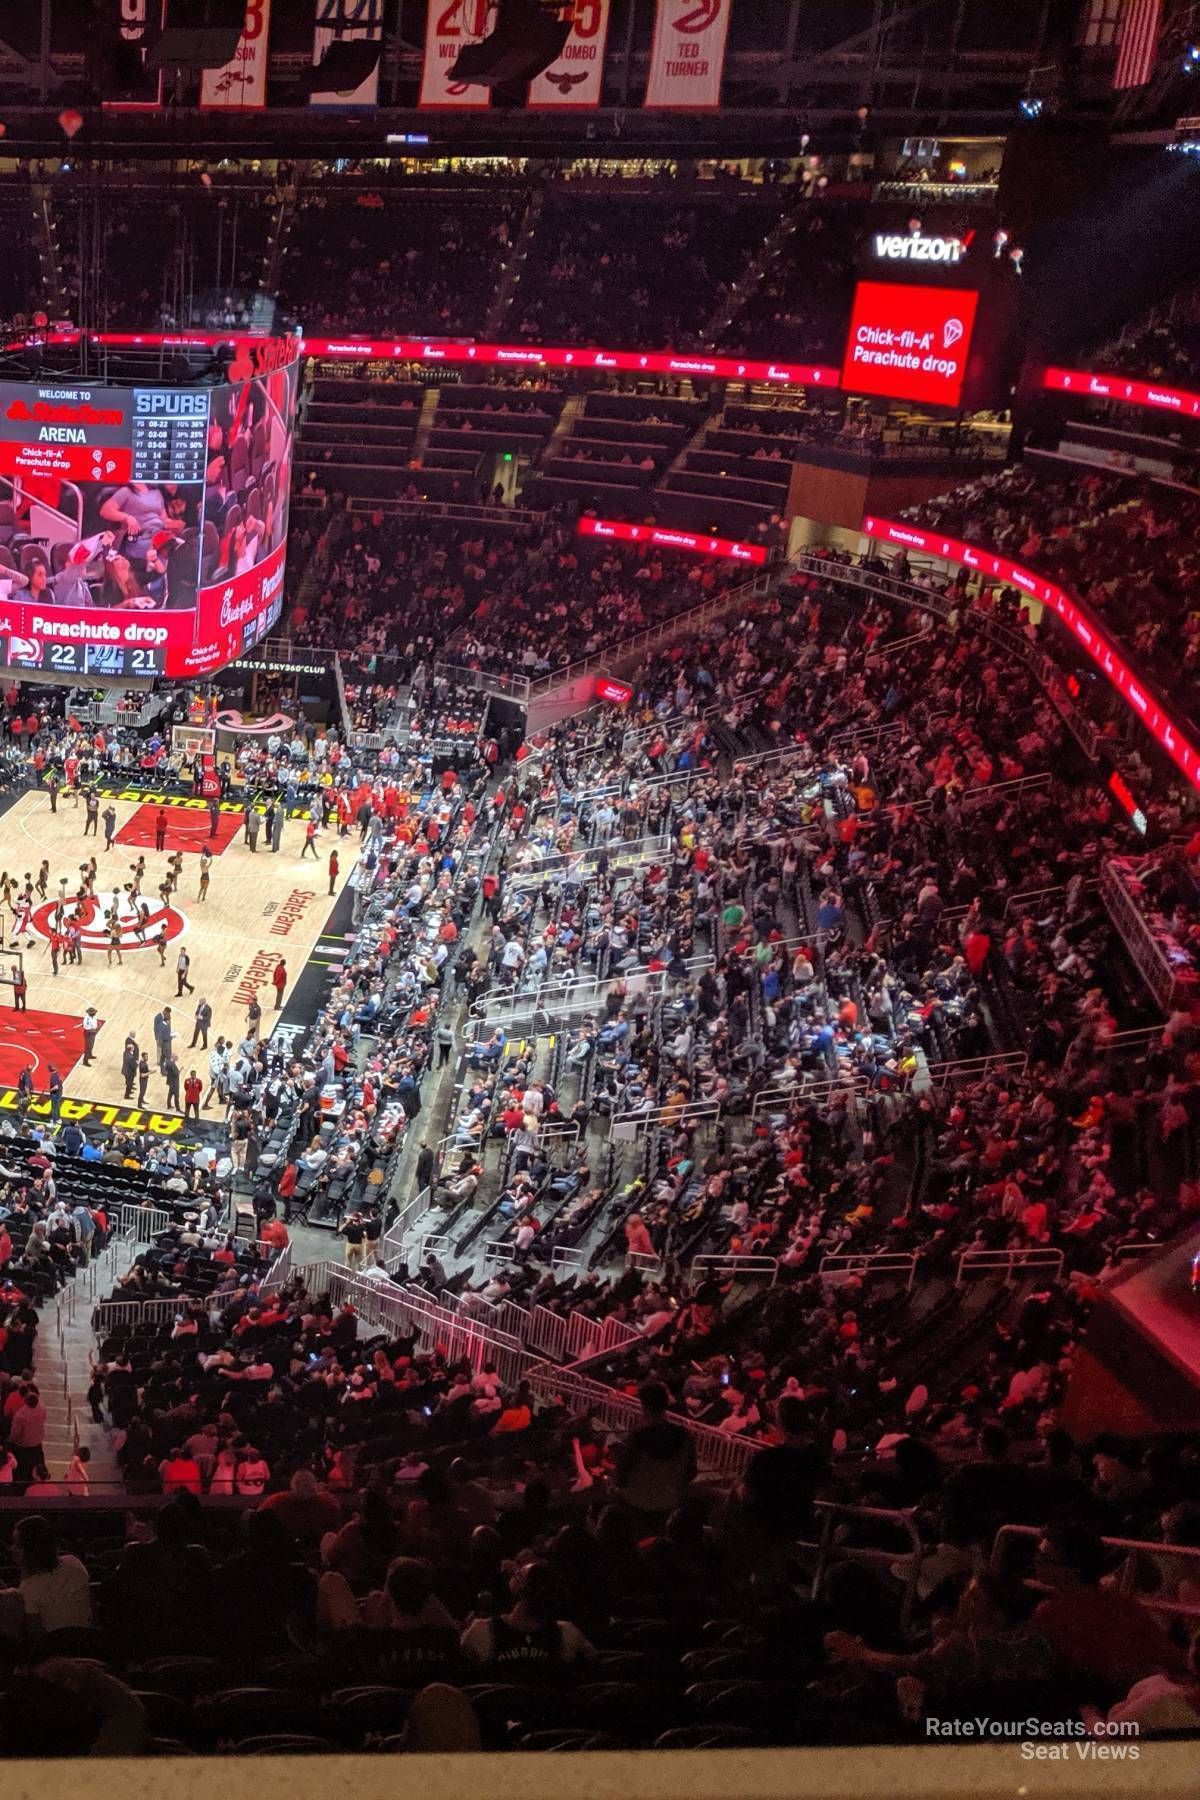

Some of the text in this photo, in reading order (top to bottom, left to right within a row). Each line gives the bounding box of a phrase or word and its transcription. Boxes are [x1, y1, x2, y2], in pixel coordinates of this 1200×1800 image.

[236, 47, 256, 61] SON
[678, 43, 700, 58] TED
[665, 61, 709, 77] TURNER
[876, 232, 961, 261] verizon
[857, 326, 932, 350] Chick-fil-A
[670, 360, 700, 370] Parachute
[854, 346, 957, 377] Parachute drop
[39, 389, 91, 400] WELCOME TO
[136, 394, 208, 413] SPURS
[39, 426, 87, 443] ARENA
[22, 448, 62, 458] Chick-fil-A
[16, 457, 71, 469] Parachute drop
[32, 616, 168, 645] Parachute drop
[51, 644, 76, 664] 22
[131, 649, 156, 668] 21
[236, 661, 266, 670] DELTA
[261, 901, 280, 917] ARENA
[223, 964, 243, 983] ARENA
